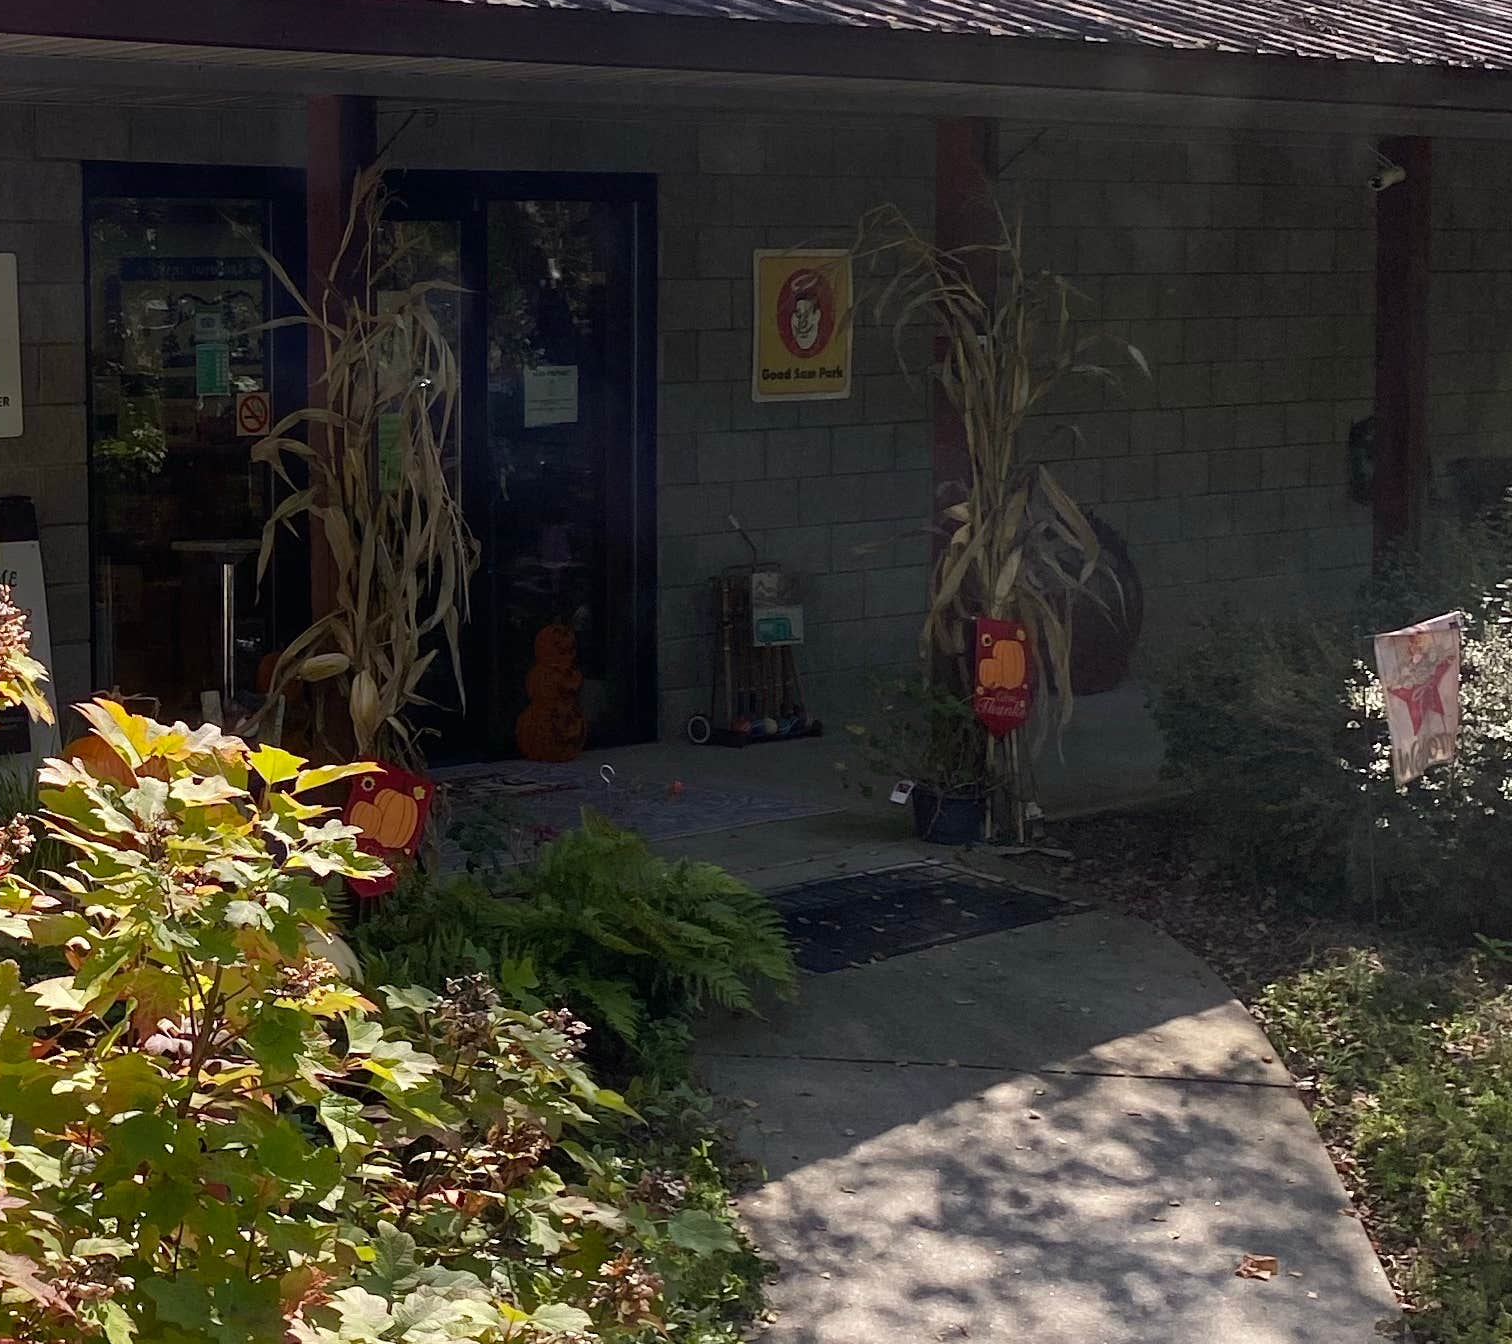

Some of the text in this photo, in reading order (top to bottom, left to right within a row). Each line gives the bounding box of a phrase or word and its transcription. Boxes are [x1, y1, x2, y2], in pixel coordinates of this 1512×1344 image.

[762, 365, 843, 380] Good Sam Park
